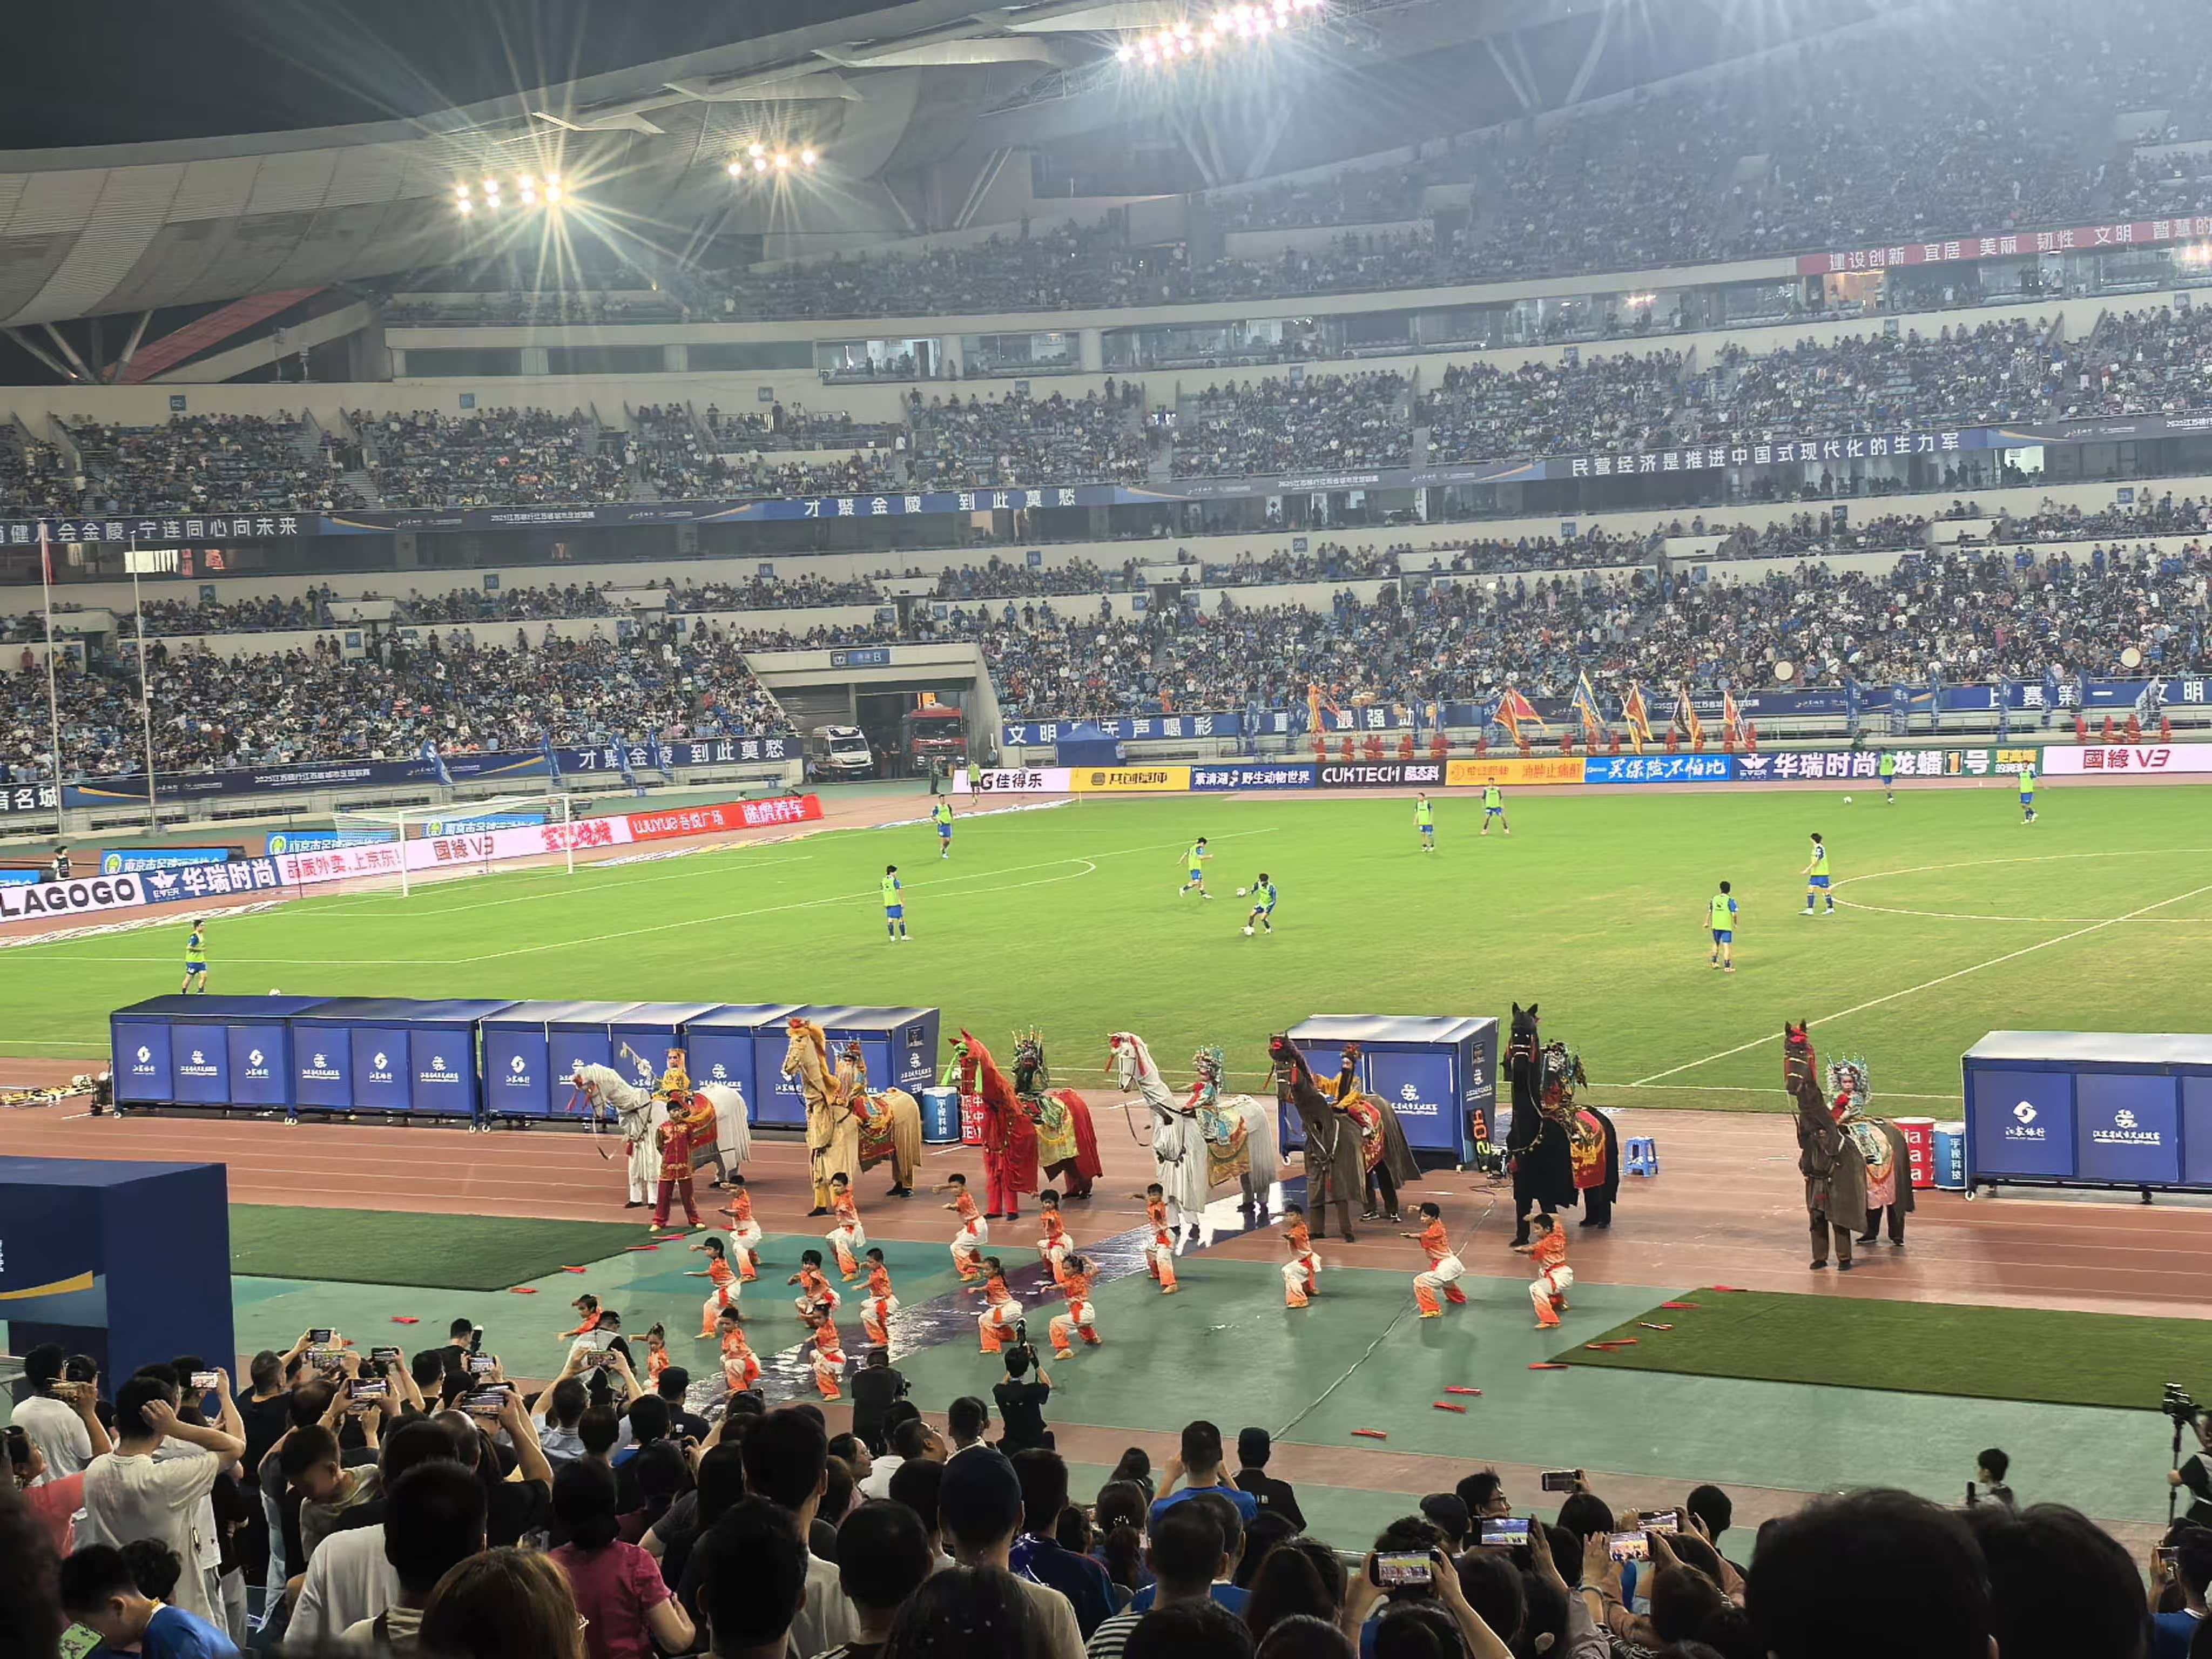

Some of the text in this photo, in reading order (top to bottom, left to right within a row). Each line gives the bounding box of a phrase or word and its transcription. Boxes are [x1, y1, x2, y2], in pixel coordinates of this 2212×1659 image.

[1829, 247, 1905, 271] 建设创新
[1923, 241, 1960, 261] 宜居
[1980, 236, 2017, 255] 美丽
[2037, 230, 2074, 251] 韧性
[2095, 224, 2132, 244] 文明
[1572, 432, 1958, 476] 民营经济是推进中国式现代化的生力军
[805, 488, 1075, 517] 才聚金陵 到此莫愁
[0, 517, 298, 543] 健儿会金陵 宁连同心向未来
[1008, 717, 1213, 744] 文明无声喝彩
[691, 739, 784, 763] 到此莫愁
[2136, 750, 2170, 767] V3
[1242, 771, 1310, 785] 野生动物世界
[1322, 766, 1399, 782] CUKTECH
[1774, 752, 1876, 778] 华瑞时尚
[996, 773, 1042, 789] 佳得乐
[182, 859, 276, 895] 华瑞时尚
[0, 879, 135, 917] LAGOGO
